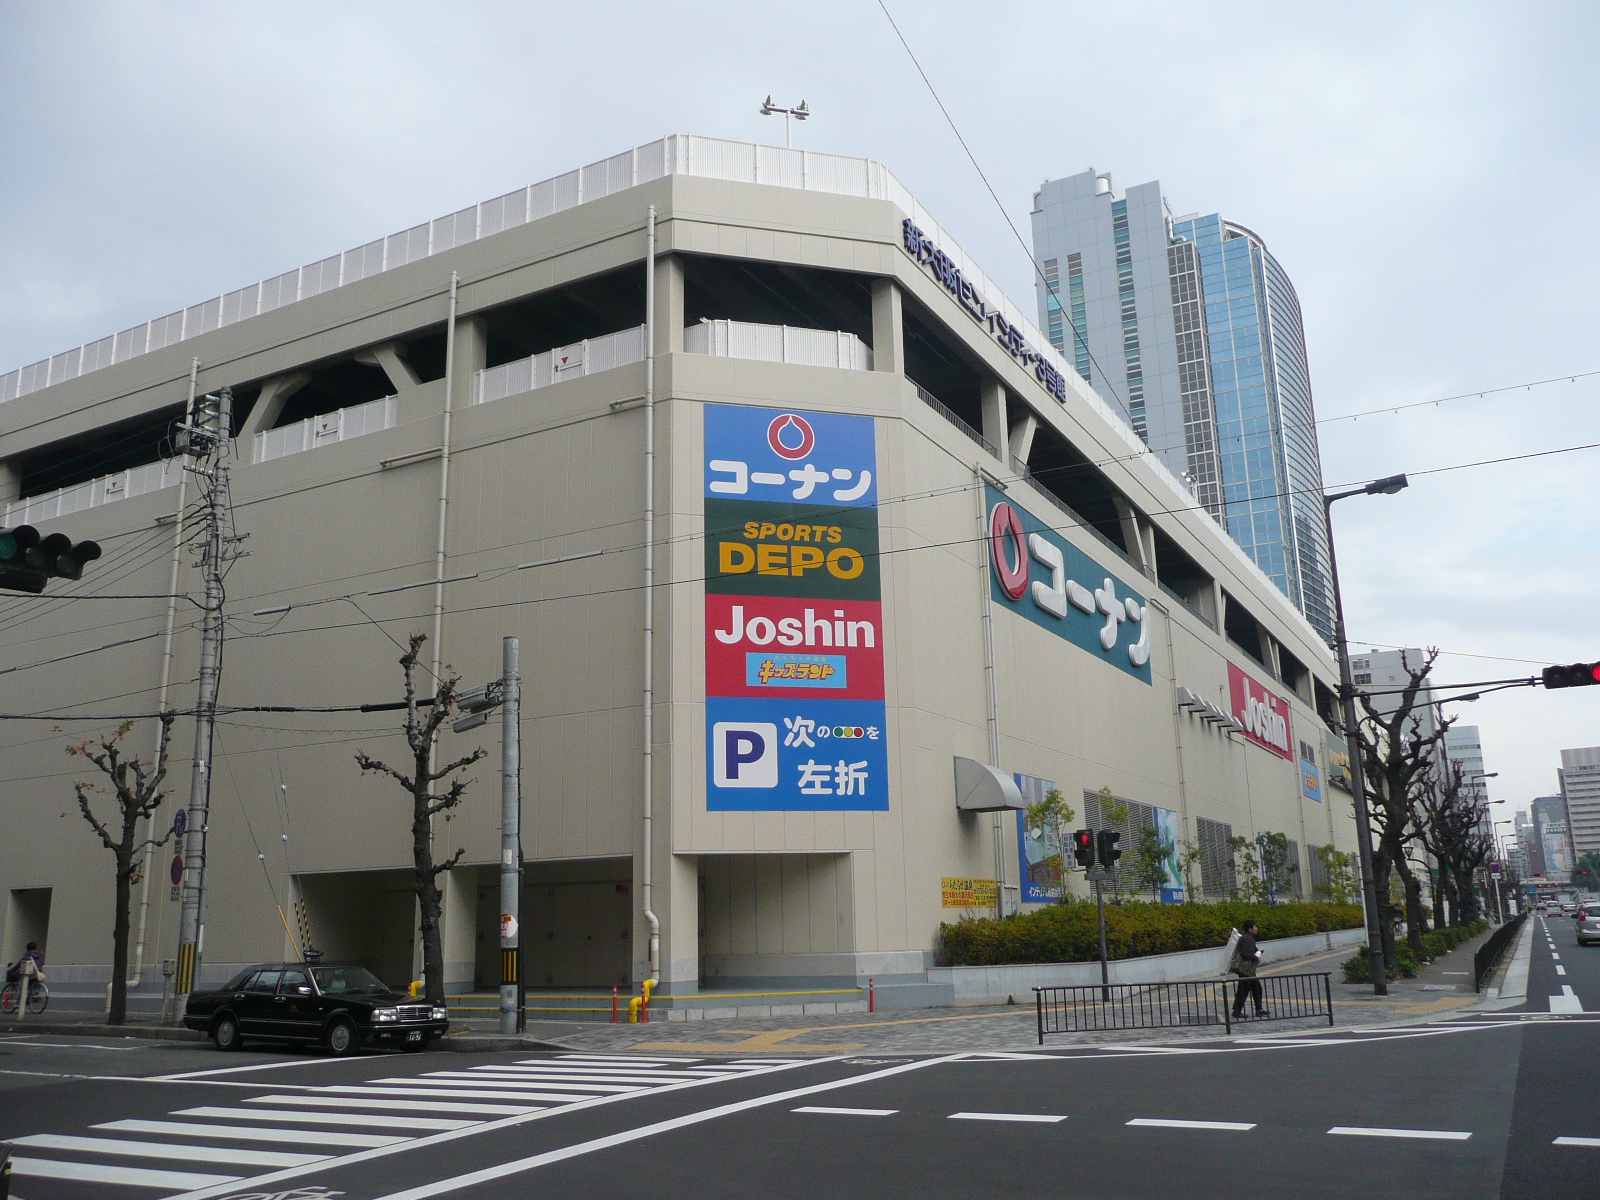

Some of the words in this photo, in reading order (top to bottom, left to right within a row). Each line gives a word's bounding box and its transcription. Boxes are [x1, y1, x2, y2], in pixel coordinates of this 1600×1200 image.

[709, 459, 872, 501] コーナン
[743, 521, 842, 543] SPORTS
[719, 541, 865, 580] DEPO
[1028, 532, 1151, 667] コーナン
[714, 605, 875, 648] Joshin
[758, 659, 835, 684] キッズランド
[1241, 677, 1288, 752] Joshin
[725, 729, 766, 780] P
[797, 759, 868, 796] 左折
